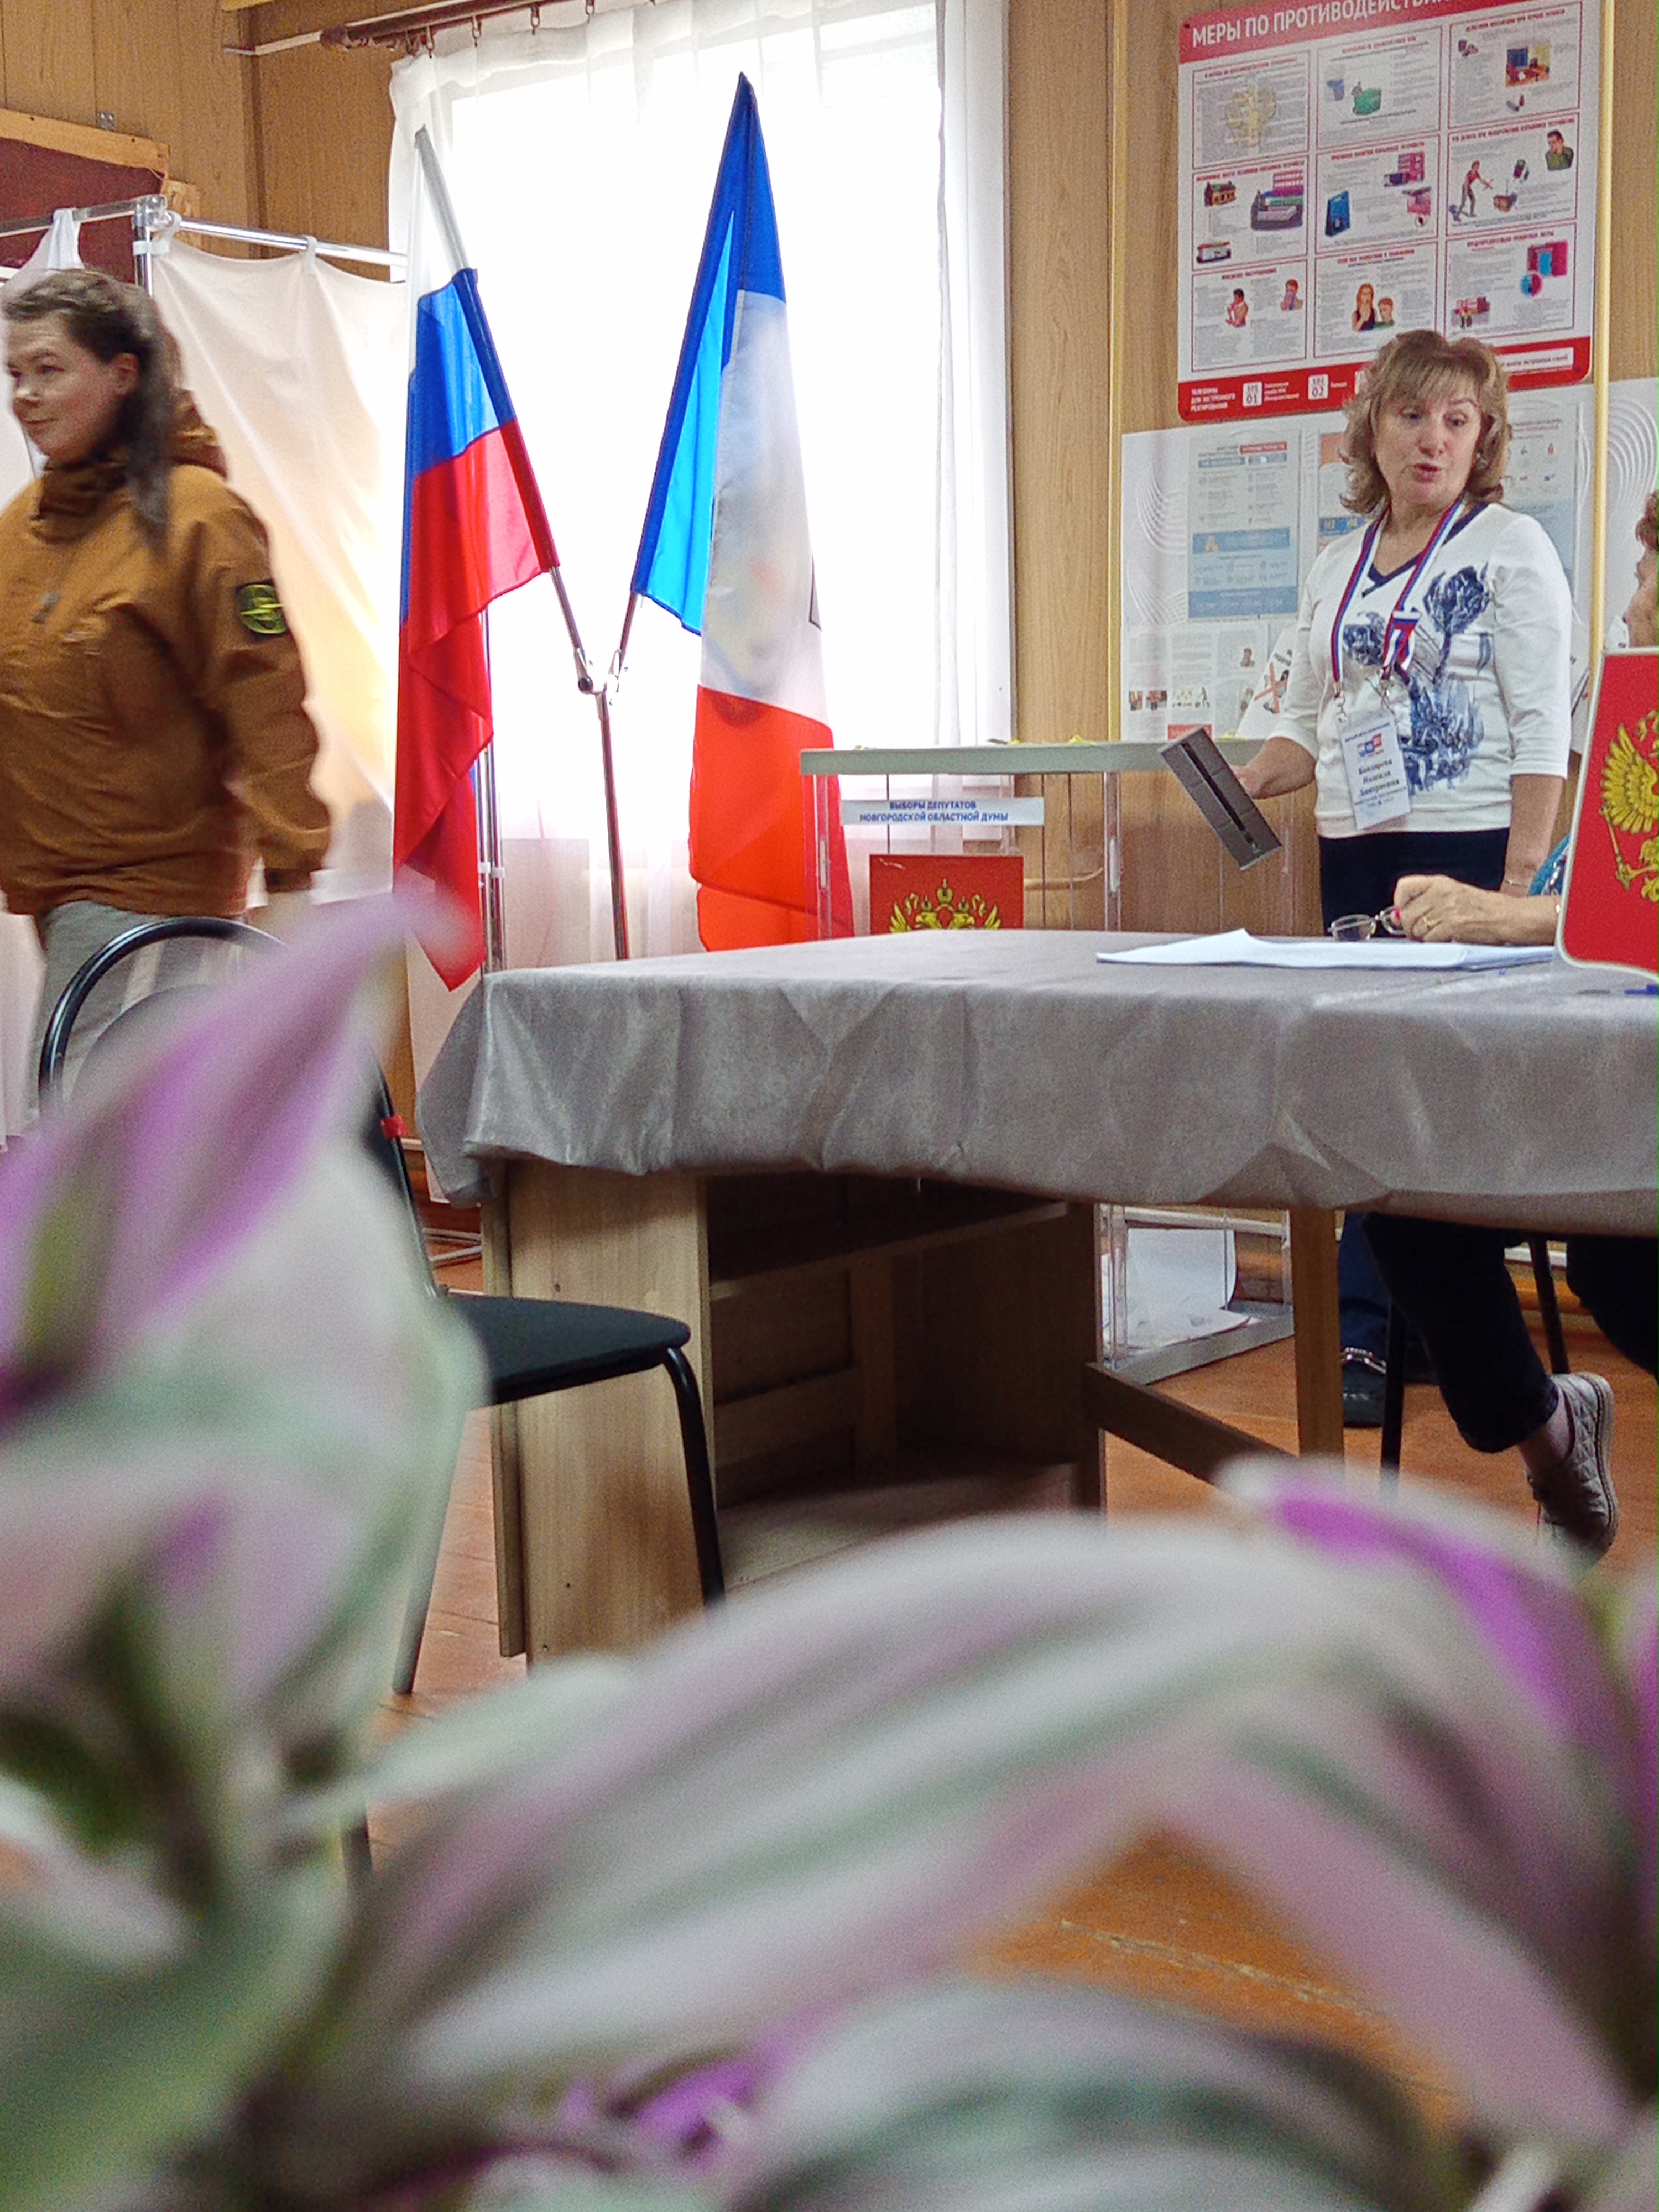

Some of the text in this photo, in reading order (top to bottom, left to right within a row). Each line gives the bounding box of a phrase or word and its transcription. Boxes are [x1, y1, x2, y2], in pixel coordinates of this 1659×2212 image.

[1193, 19, 1241, 48] МЕРЫ
[1246, 14, 1269, 37] ПО
[1312, 386, 1324, 397] 02
[1246, 394, 1257, 404] 01
[890, 801, 977, 810] ВЫБОРЫ ДЕПУТАТОВ
[859, 810, 1008, 822] НОВГОРОДСКОЙ ОБЛАСТНОЙ ДУМЫ
